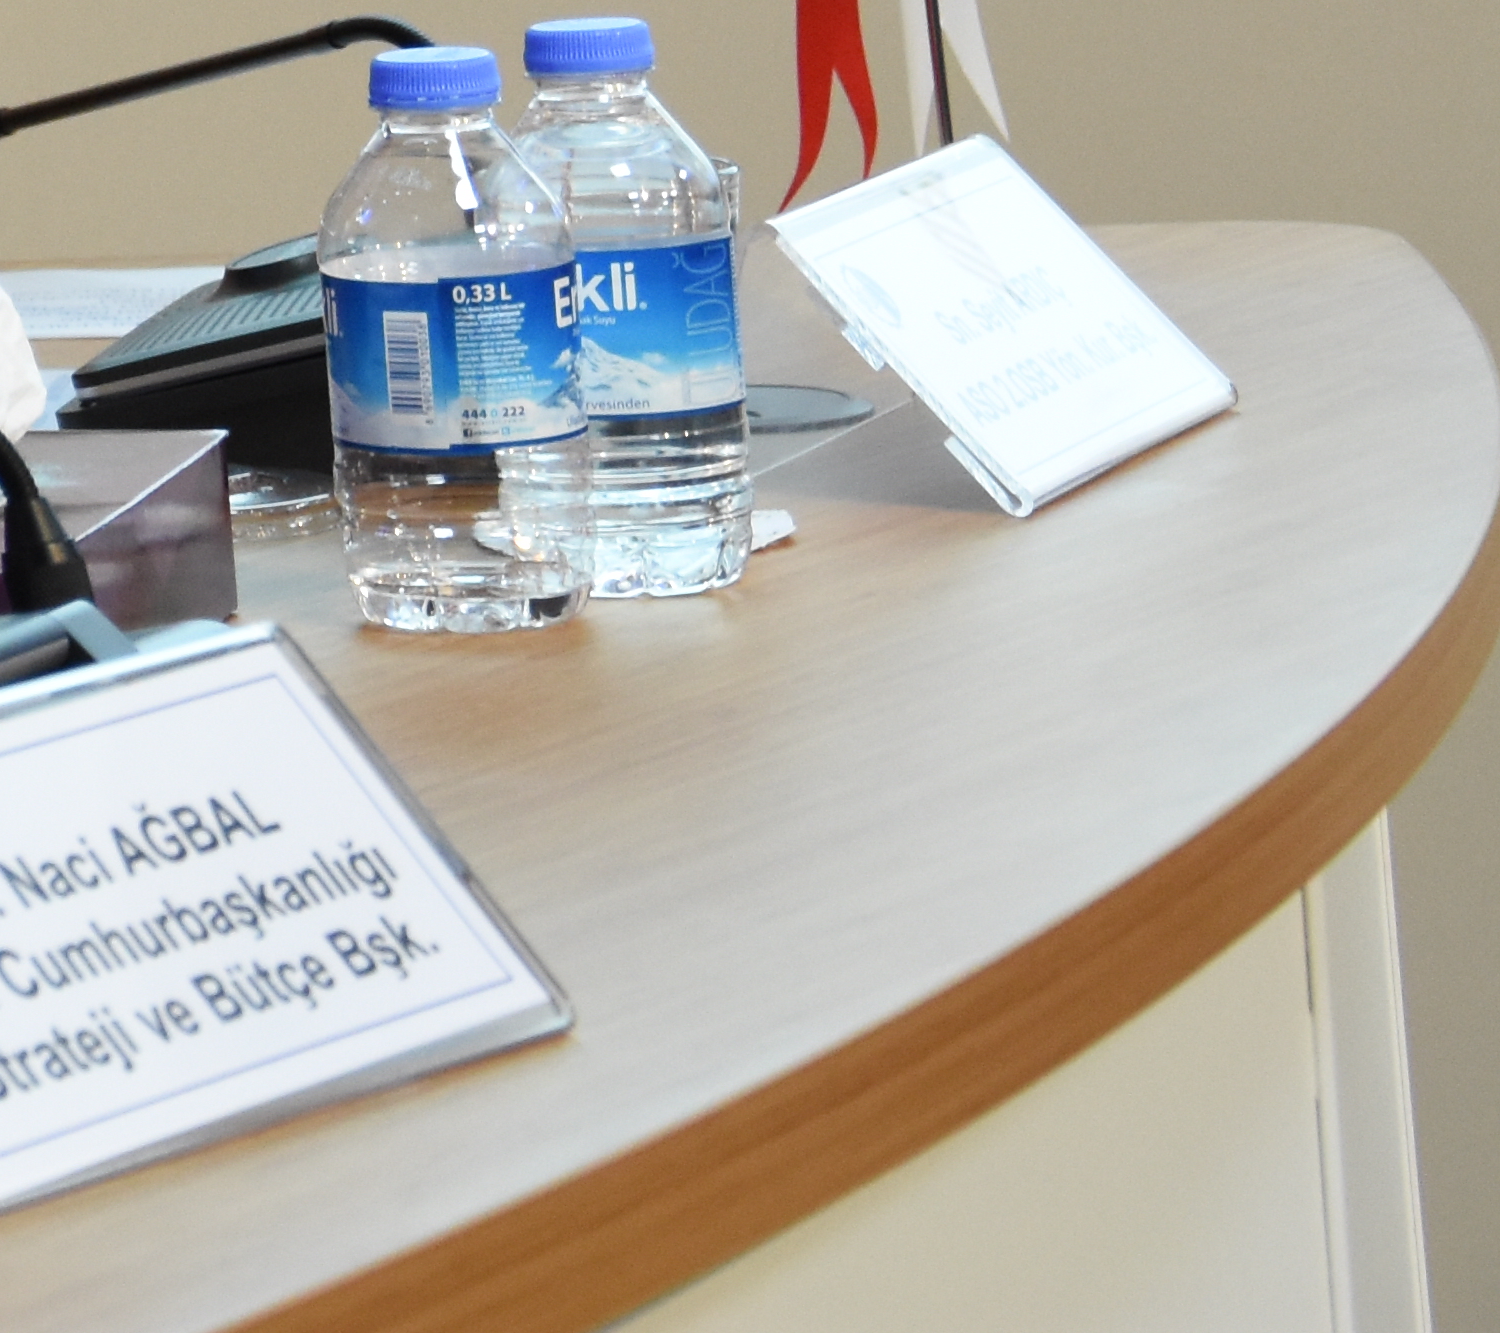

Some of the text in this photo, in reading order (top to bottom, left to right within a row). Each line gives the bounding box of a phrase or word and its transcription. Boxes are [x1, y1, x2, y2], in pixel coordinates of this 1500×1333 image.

[452, 281, 512, 305] 0,33 L
[461, 408, 487, 420] 444
[502, 405, 525, 418] 222
[586, 398, 650, 411] rvesinden
[111, 790, 282, 875] AĞBAL
[136, 997, 200, 1043] ve
[192, 949, 336, 1023] Bütçe
[325, 916, 441, 980] Bşk.
